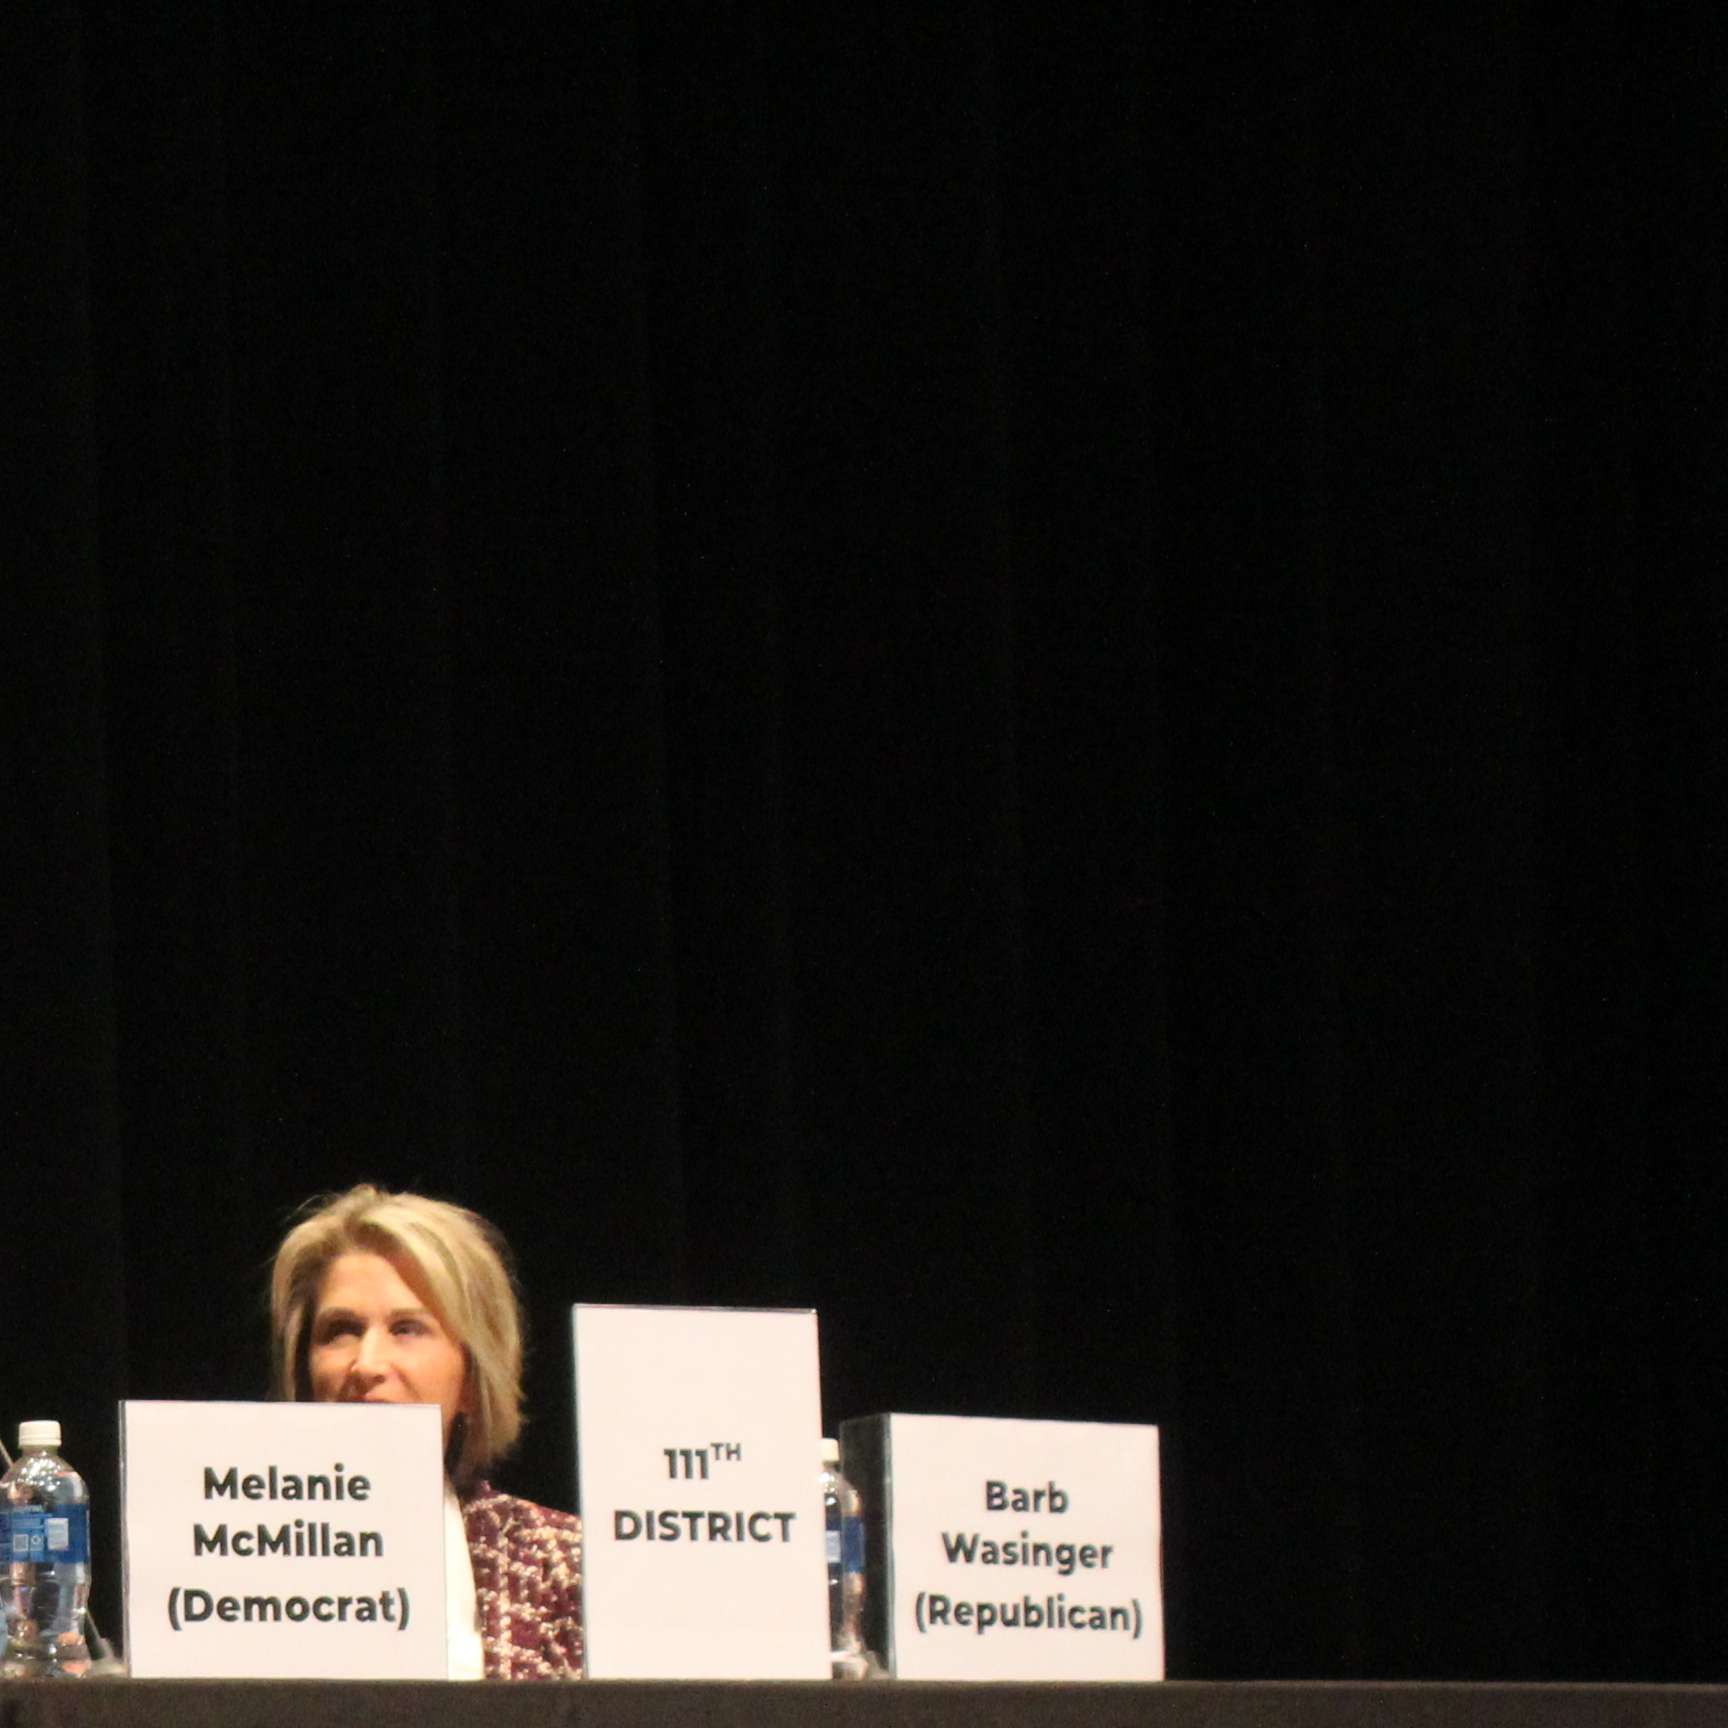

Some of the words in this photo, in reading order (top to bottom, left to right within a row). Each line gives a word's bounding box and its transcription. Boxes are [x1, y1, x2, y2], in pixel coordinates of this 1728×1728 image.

[663, 1442, 741, 1479] 111TH
[204, 1465, 371, 1501] Melanie
[985, 1480, 1068, 1514] Barb
[193, 1519, 383, 1557] McMillan
[614, 1510, 796, 1543] DISTRICT
[941, 1533, 1113, 1576] Wasinger
[167, 1587, 410, 1631] (Democrat)
[915, 1592, 1143, 1639] (Republican)
